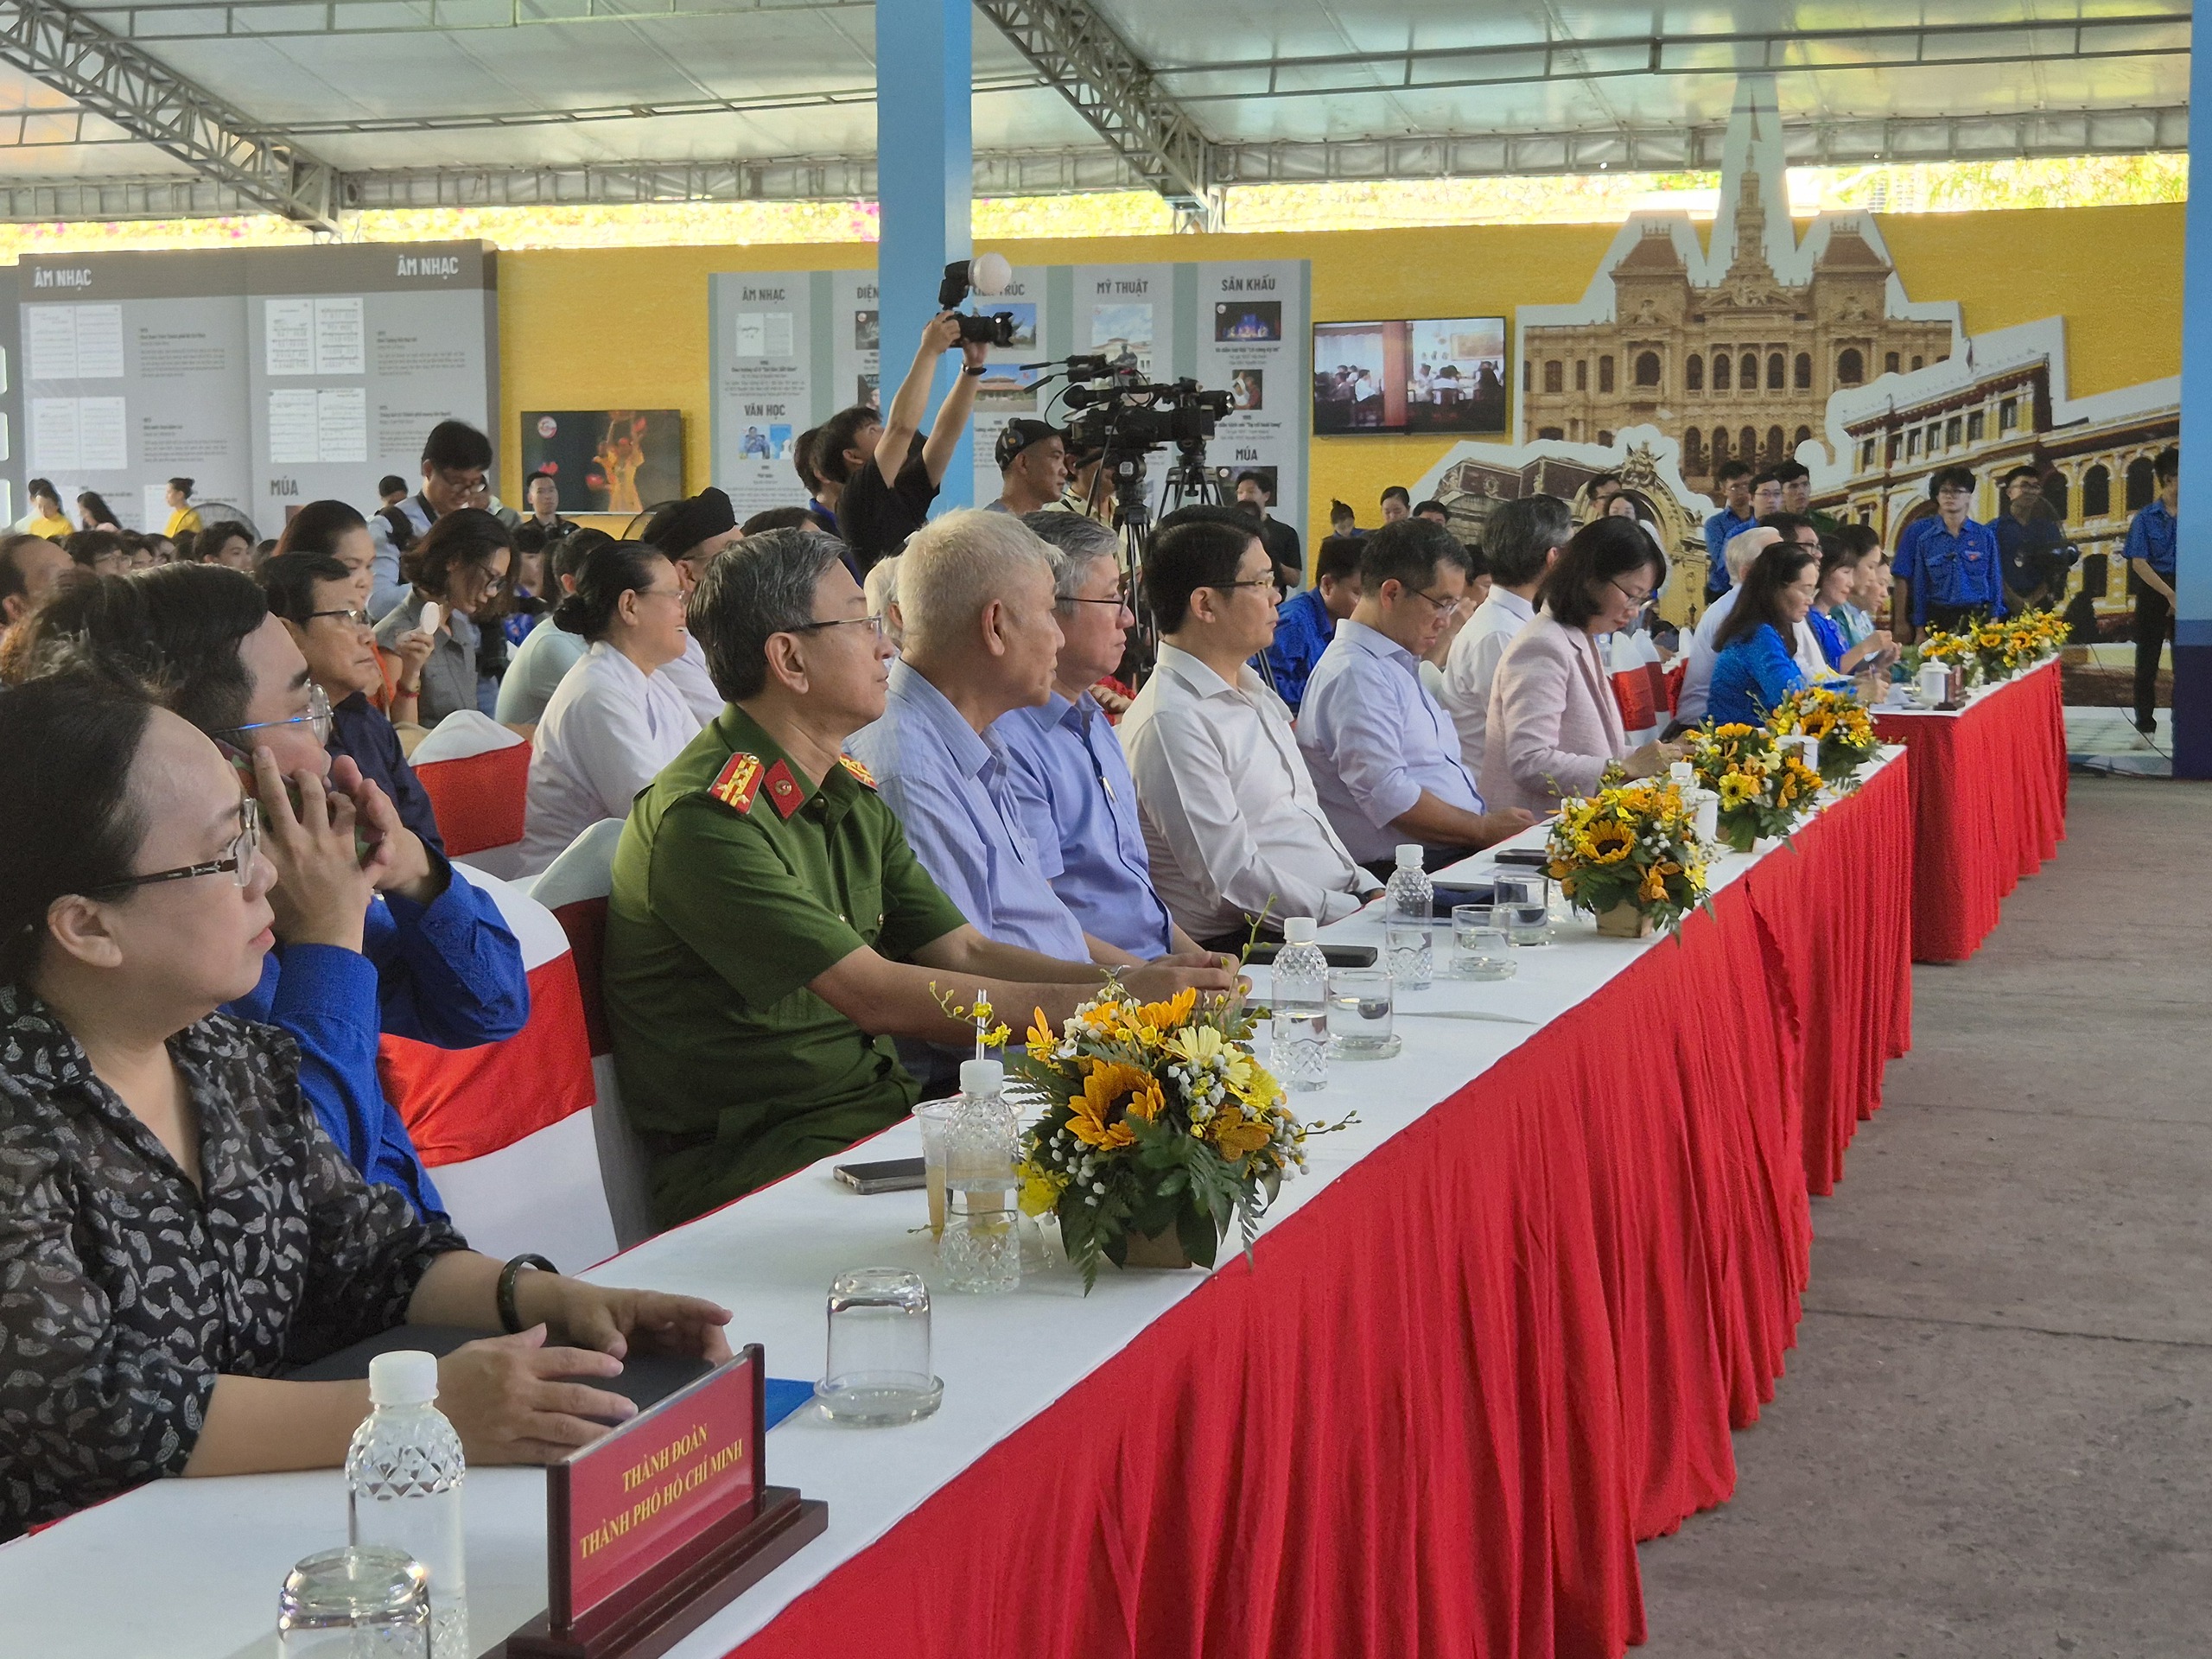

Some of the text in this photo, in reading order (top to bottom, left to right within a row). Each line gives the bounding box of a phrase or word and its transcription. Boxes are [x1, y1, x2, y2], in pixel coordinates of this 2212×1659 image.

[397, 254, 459, 280] ÂM NHẠC
[35, 266, 92, 291] ÂM NHẠC
[1116, 278, 1148, 297] THUẬT
[1222, 274, 1275, 292] SÂN KHẤU
[742, 286, 785, 304] ÂM NHẠC
[999, 281, 1025, 296] RÚC
[744, 403, 785, 420] VĂN HỌC
[1236, 445, 1258, 461] MÚA
[270, 475, 299, 496] MÚA
[622, 1422, 709, 1493] THÀNH ĐOÀN
[580, 1438, 743, 1559] THÀNH PHỐ HỒ CHÍ MINH
